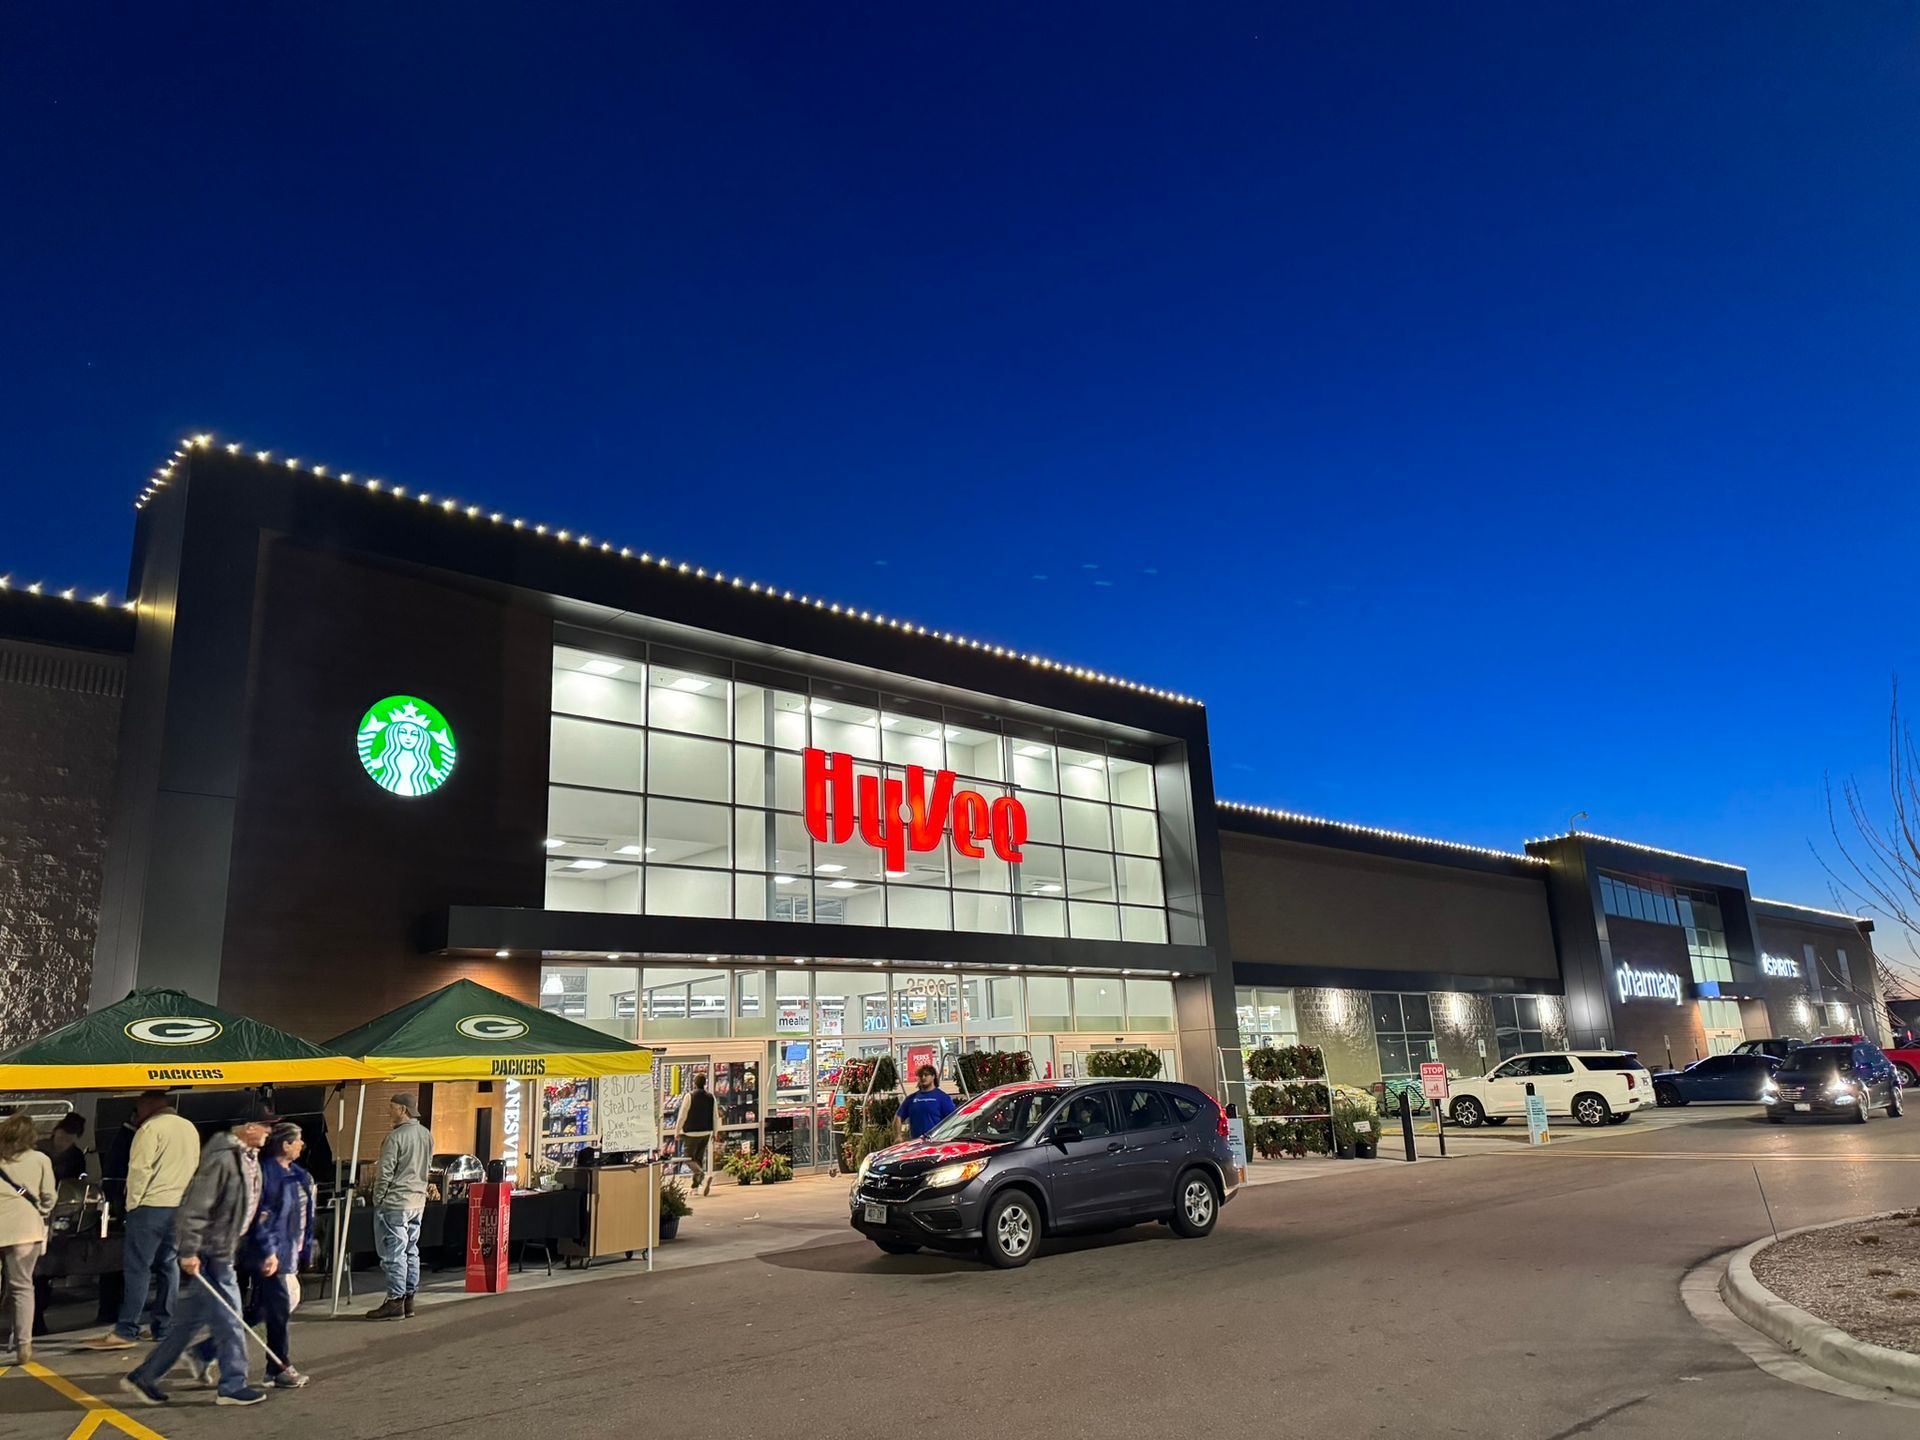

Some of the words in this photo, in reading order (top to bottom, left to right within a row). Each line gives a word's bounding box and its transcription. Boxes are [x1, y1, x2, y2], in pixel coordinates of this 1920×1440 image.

[906, 978, 947, 996] 2500
[1616, 961, 1682, 1005] pharmacy
[491, 1059, 545, 1075] PACKERS
[1422, 1066, 1443, 1074] STOP
[148, 1069, 224, 1080] PACKERS
[479, 1215, 498, 1227] FLU
[478, 1227, 497, 1236] SHOT
[478, 1235, 497, 1245] GET
